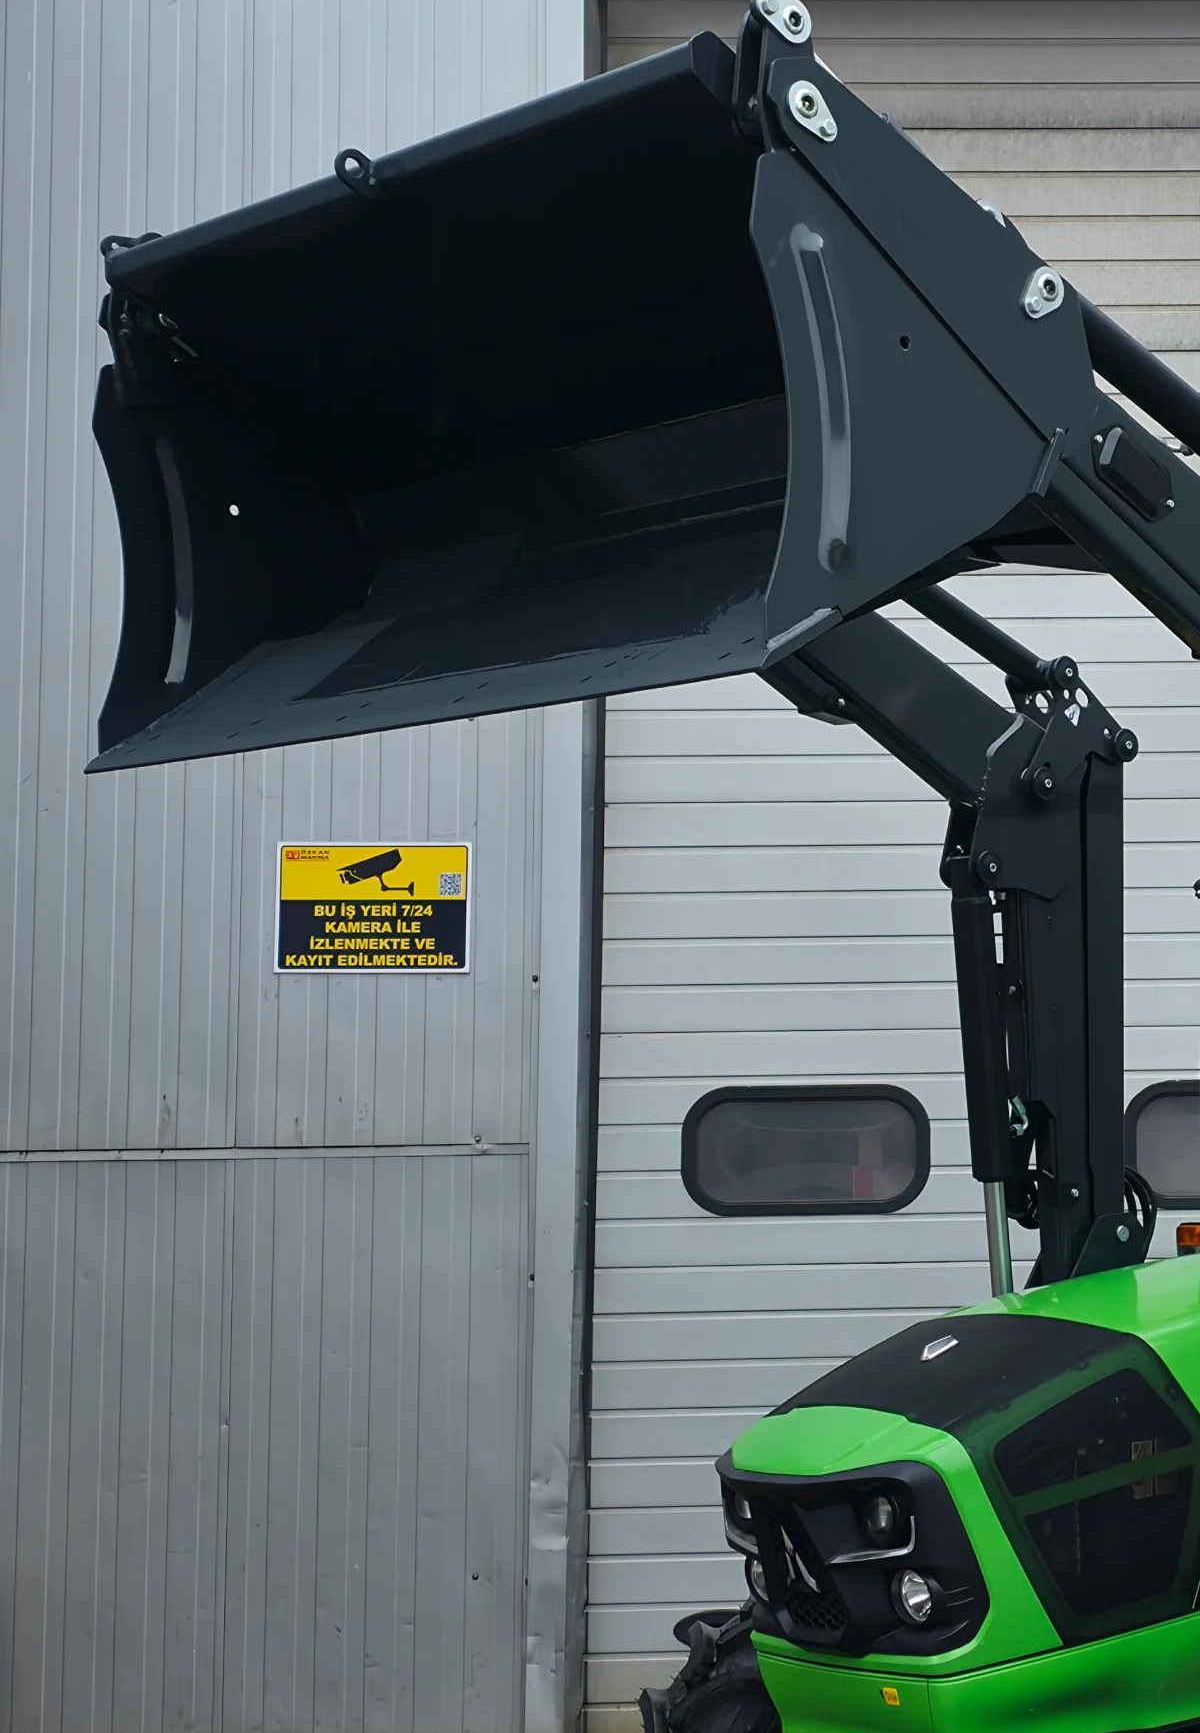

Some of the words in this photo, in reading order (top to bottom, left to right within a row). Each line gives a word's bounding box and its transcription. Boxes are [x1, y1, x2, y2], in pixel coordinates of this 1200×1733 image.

[314, 905, 336, 917] BU
[341, 903, 356, 919] İŞ
[360, 903, 397, 917] YERİ
[401, 905, 433, 917] 7/24
[325, 921, 392, 933] KAMERA
[396, 919, 421, 933] İLE
[309, 936, 410, 950] İZLENMEKTE
[415, 938, 435, 950] VE
[285, 954, 333, 966] KAYIT
[337, 952, 458, 966] EDİLMEKTEDİR.
